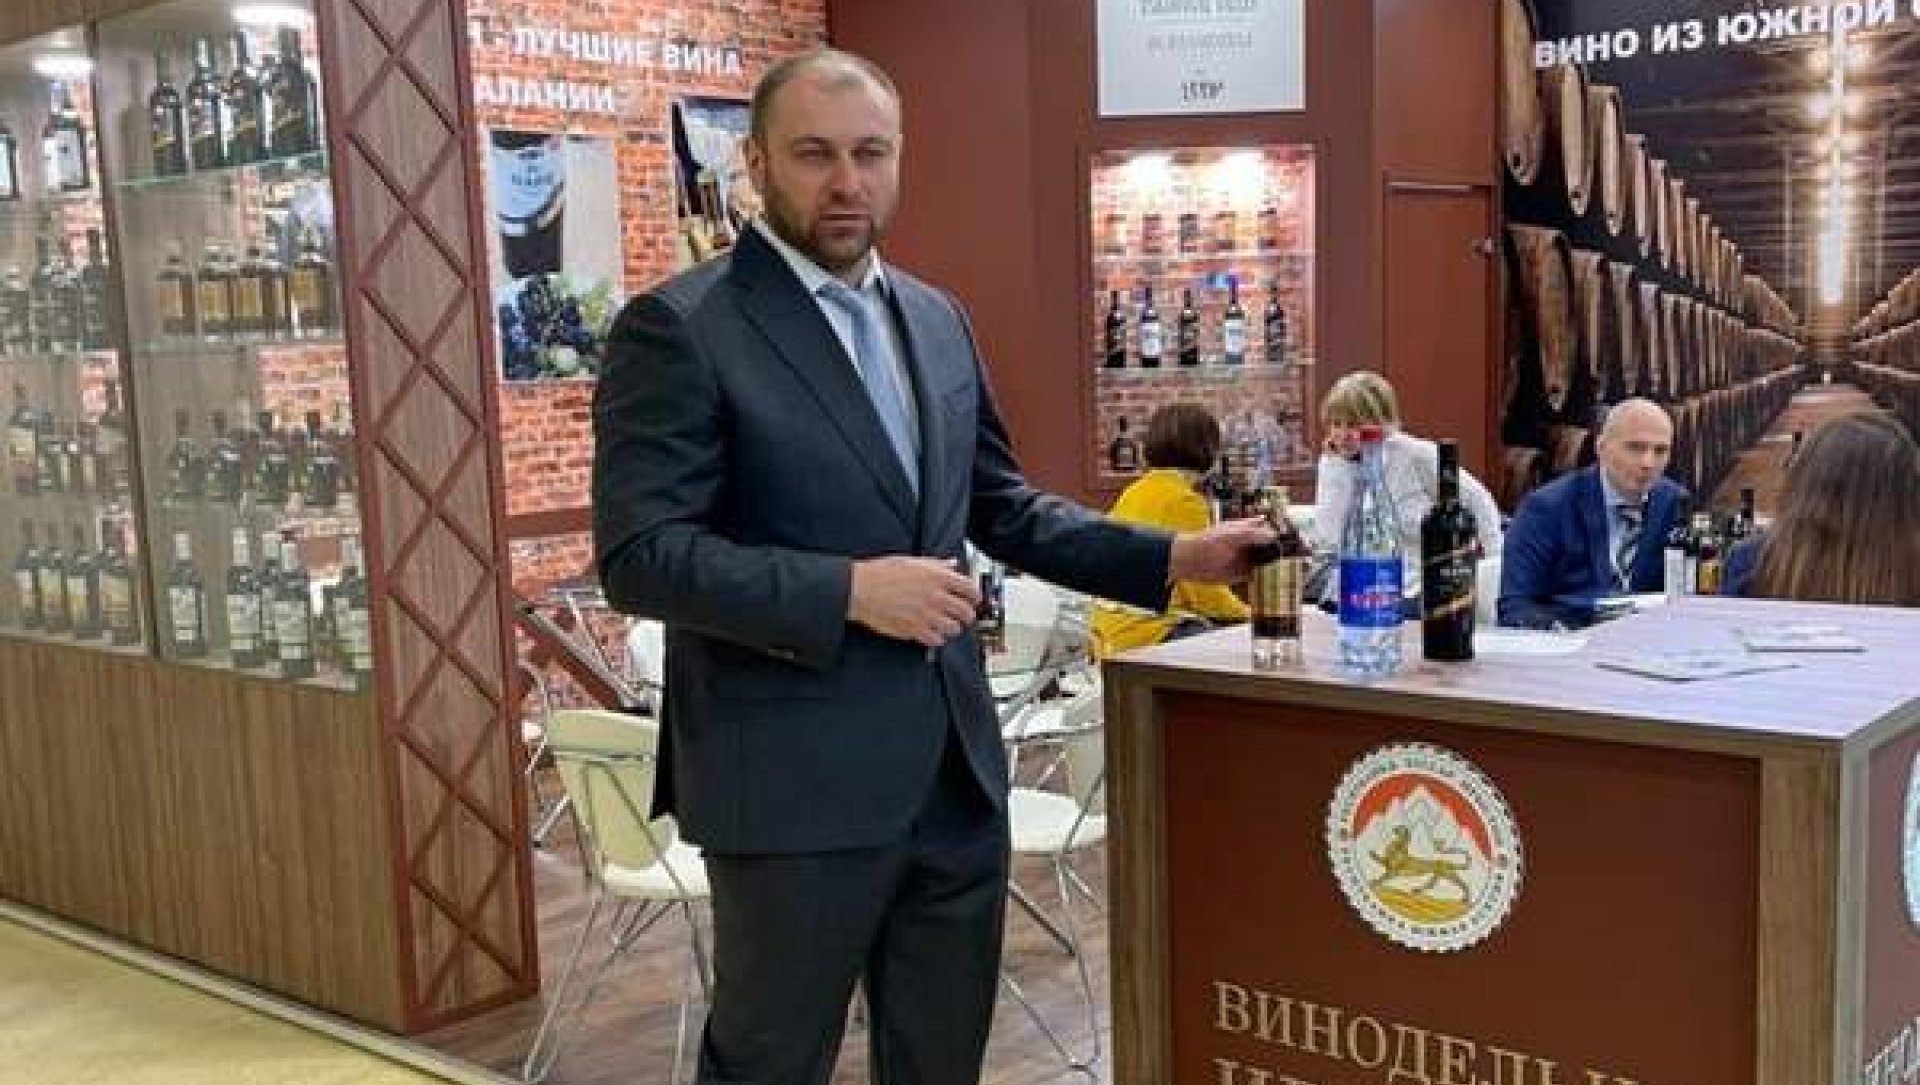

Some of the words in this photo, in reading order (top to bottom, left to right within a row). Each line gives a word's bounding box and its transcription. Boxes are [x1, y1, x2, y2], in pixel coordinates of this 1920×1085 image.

[512, 28, 653, 66] ЛУЧШИЕ
[664, 43, 743, 75] ВИНА
[1534, 28, 1640, 68] ВИНО
[1651, 19, 1705, 54] ИЗ
[474, 76, 613, 111] АЛАНИИ
